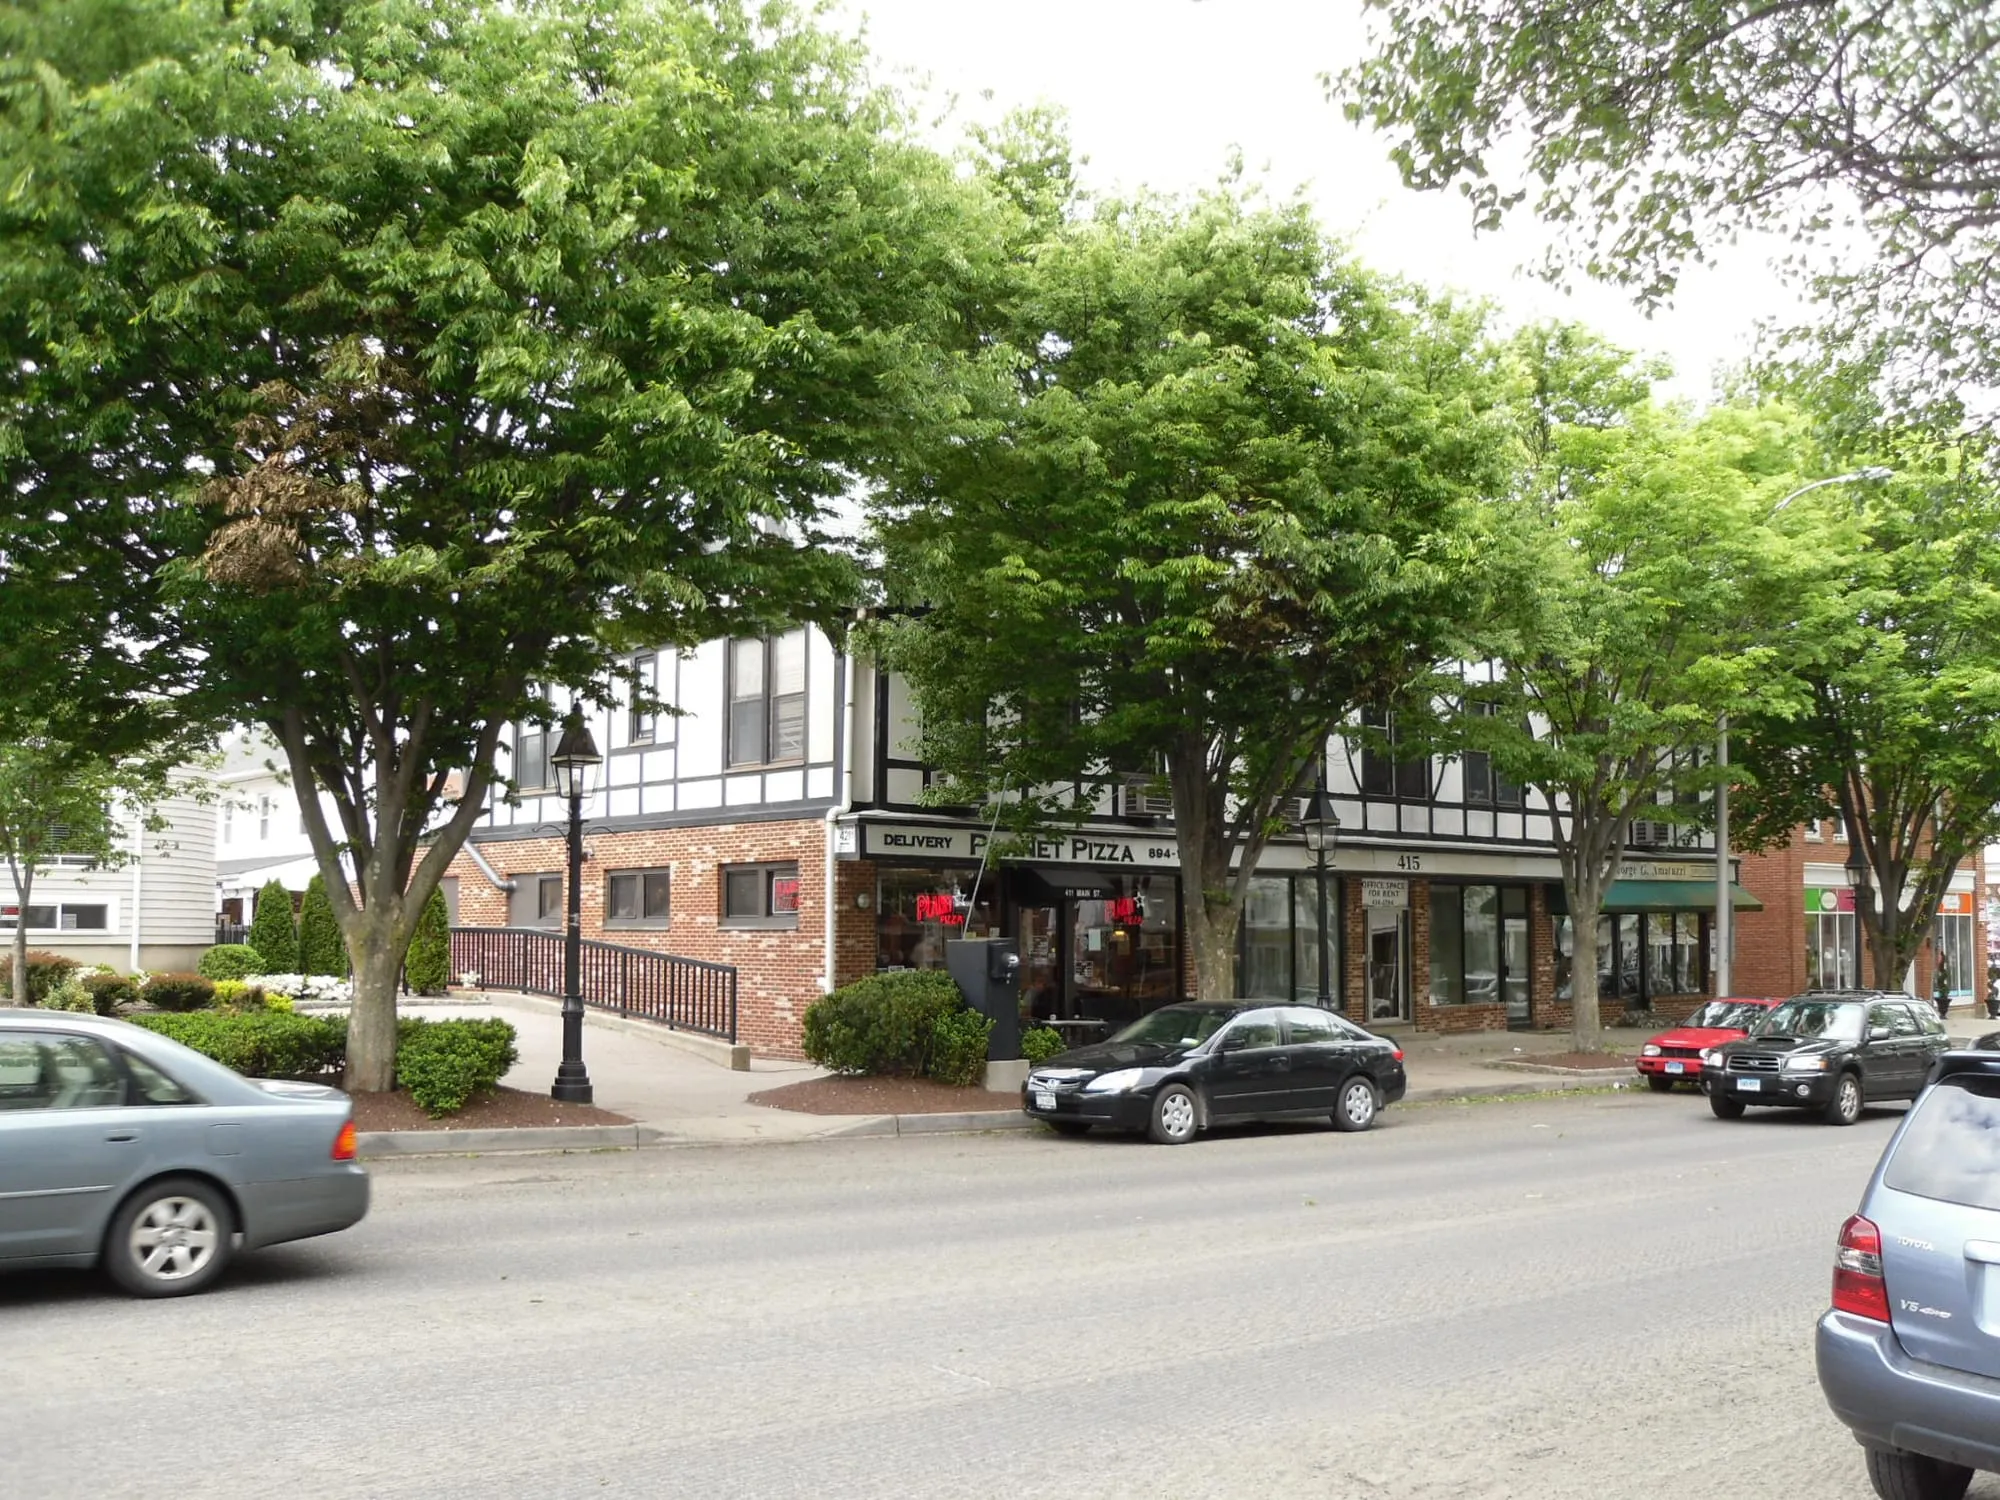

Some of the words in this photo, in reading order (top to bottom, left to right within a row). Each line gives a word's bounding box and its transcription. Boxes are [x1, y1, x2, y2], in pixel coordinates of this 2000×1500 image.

[883, 833, 953, 849] DELIVERY
[1071, 838, 1135, 863] PIZZA
[1397, 855, 1421, 871] 415
[1076, 888, 1091, 897] MAIN
[1368, 889, 1380, 897] FOR
[1897, 1236, 1934, 1251] TOYOTA
